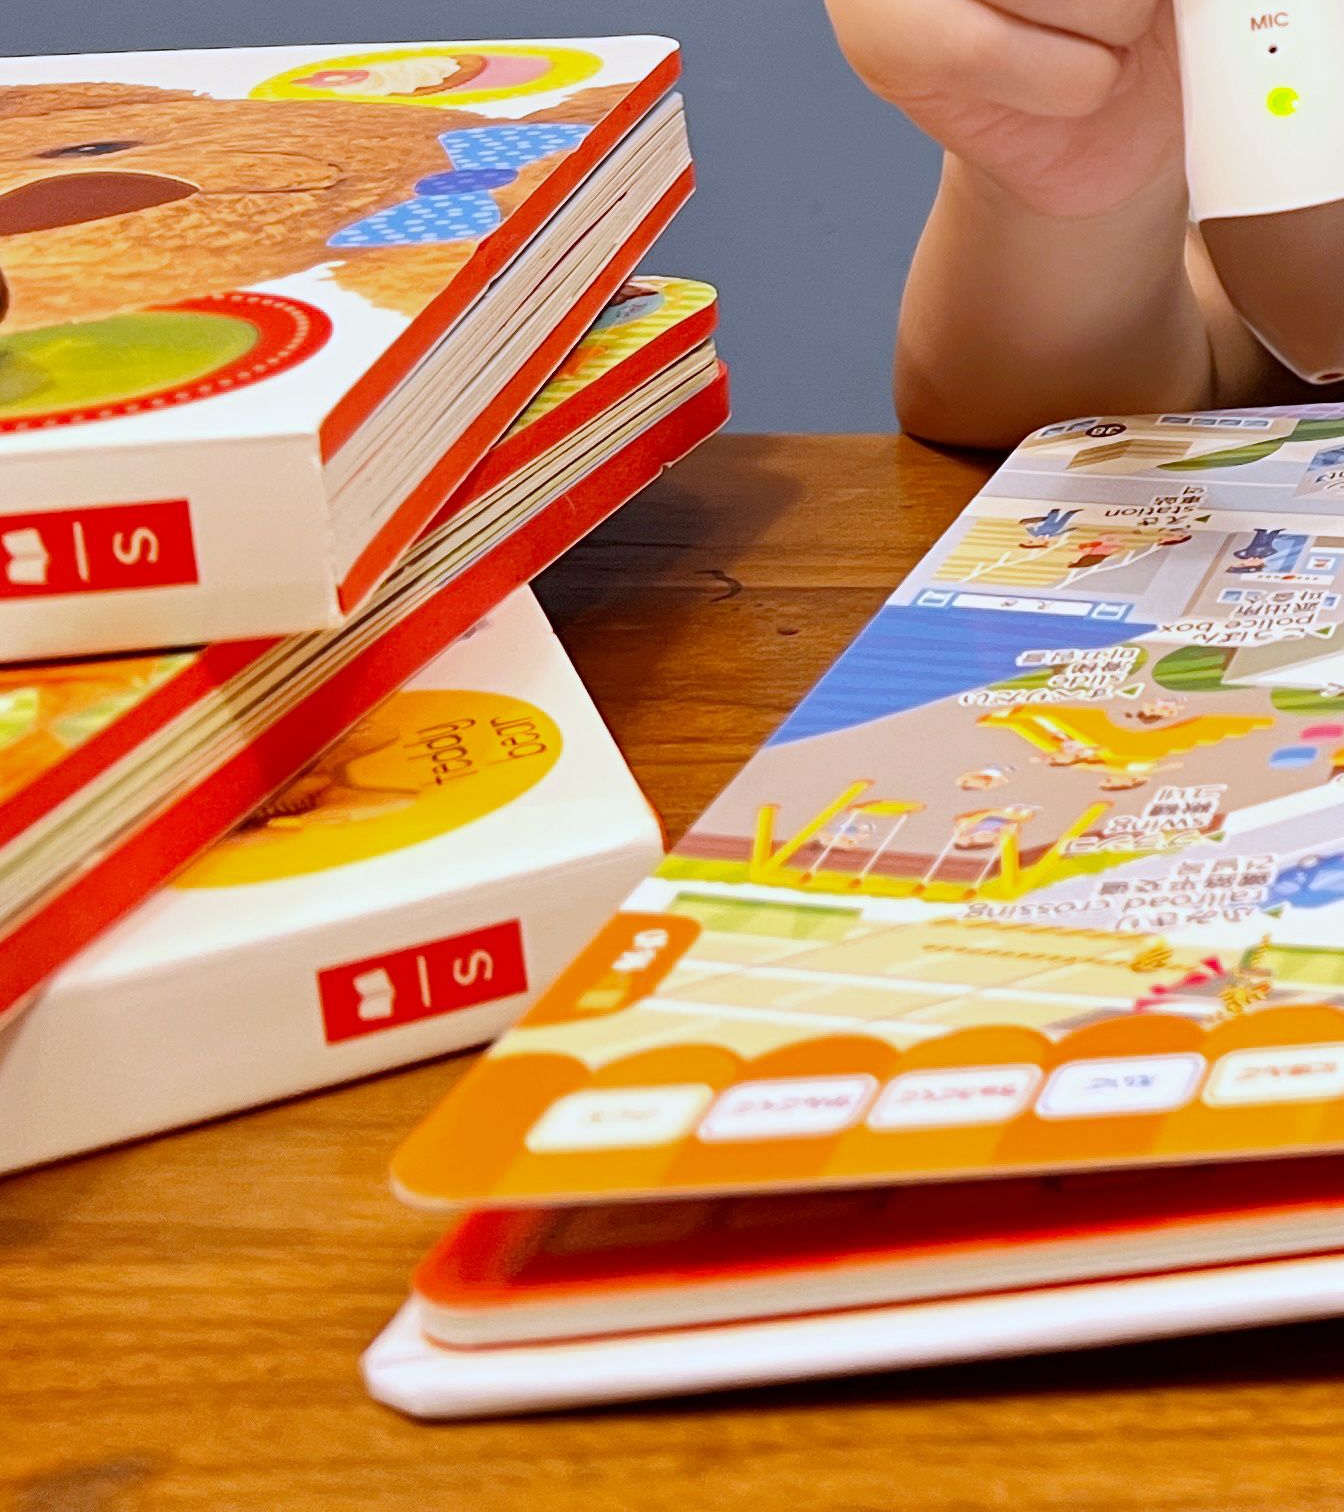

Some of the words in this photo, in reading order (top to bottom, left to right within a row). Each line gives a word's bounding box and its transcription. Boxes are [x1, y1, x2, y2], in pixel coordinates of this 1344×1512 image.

[1249, 10, 1290, 32] MIC
[1104, 506, 1197, 518] station
[1158, 622, 1214, 633] box
[1225, 614, 1314, 630] police
[1193, 628, 1305, 643] こうばん
[1052, 674, 1120, 688] slide
[486, 716, 547, 766] bear
[402, 717, 478, 785] teddy
[1107, 818, 1204, 834] swing
[1123, 890, 1262, 912] railroad
[962, 898, 1110, 924] crossing
[1115, 908, 1251, 931] ふみきり
